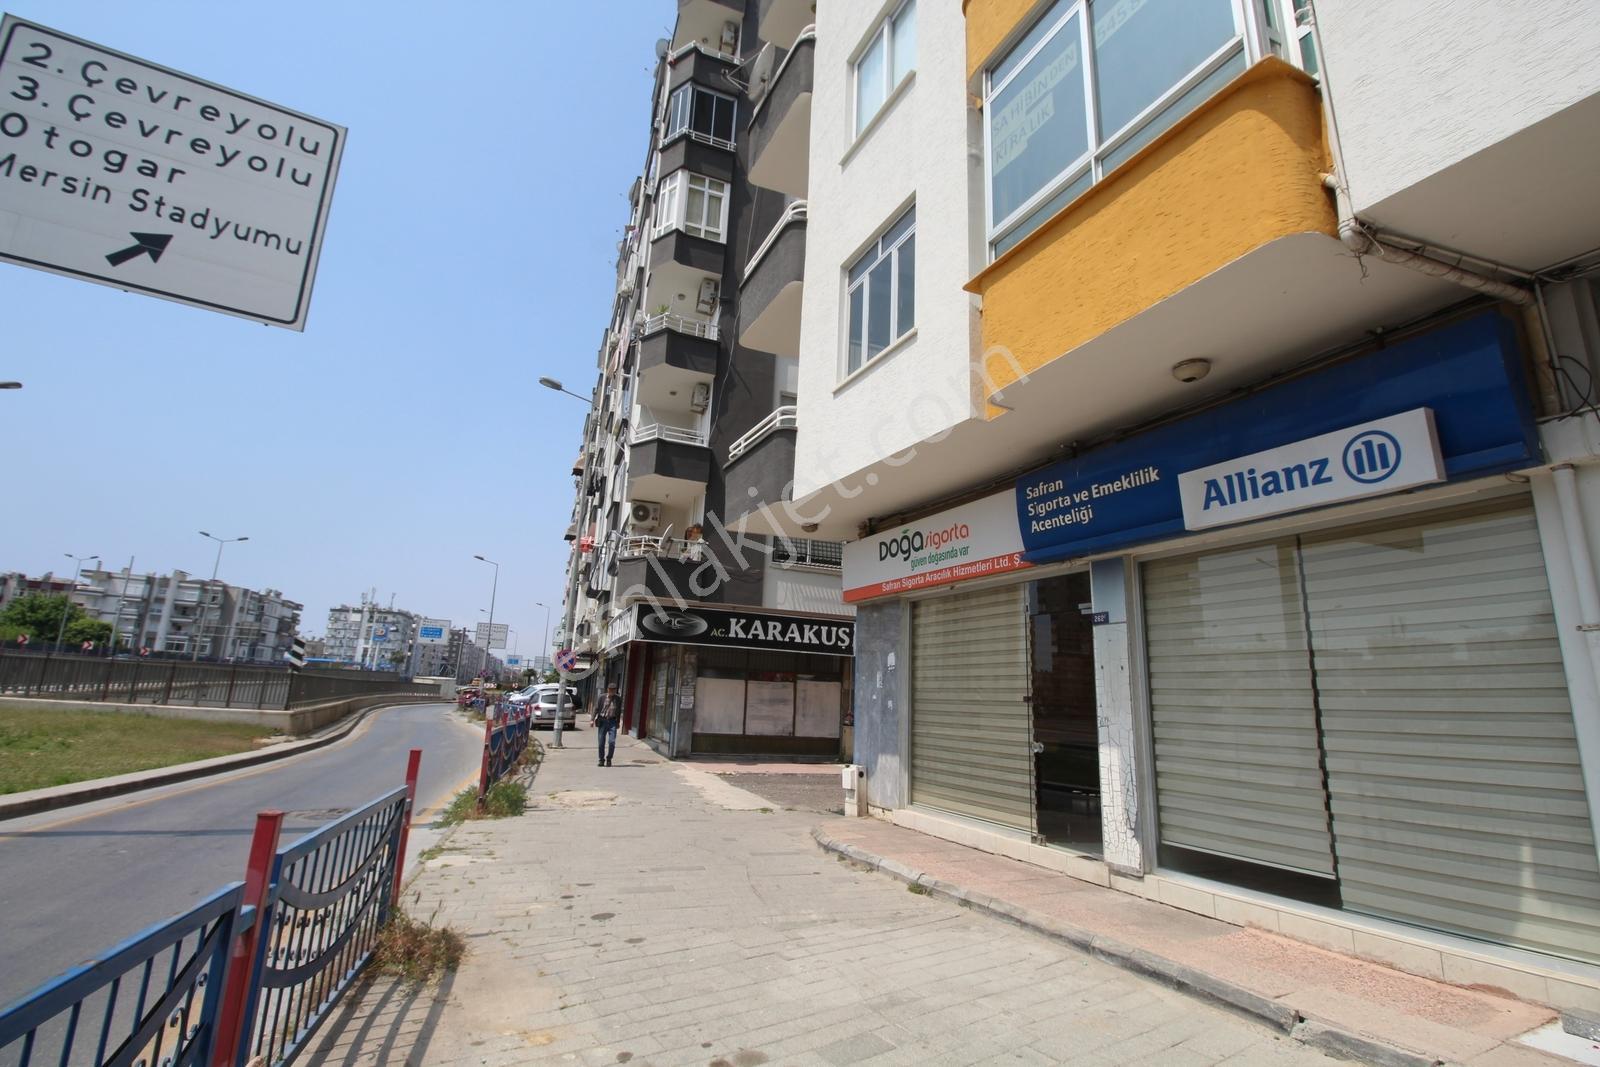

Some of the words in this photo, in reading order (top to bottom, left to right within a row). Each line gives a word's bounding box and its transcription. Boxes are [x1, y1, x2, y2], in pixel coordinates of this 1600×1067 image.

[22, 43, 64, 74] 2.
[80, 61, 322, 156] Çevreyolu
[0, 112, 187, 184] Otogar
[10, 76, 49, 108] 3.
[67, 94, 313, 187] Çevreyolu
[129, 188, 303, 256] Stadyumu
[1026, 480, 1063, 500] Safran
[1028, 495, 1071, 517] Sigorta
[1073, 491, 1089, 504] ve
[1092, 466, 1160, 499] Emeklilik
[1203, 457, 1333, 511] Allianz
[1031, 504, 1093, 533] Acenteliği
[882, 581, 901, 592] Safran
[902, 576, 924, 589] Sigorta
[953, 559, 993, 577] Hizmetleri
[994, 556, 1011, 568] Ltd.
[911, 556, 928, 571] güven
[959, 546, 970, 557] var
[729, 617, 850, 649] KARAKUŞ
